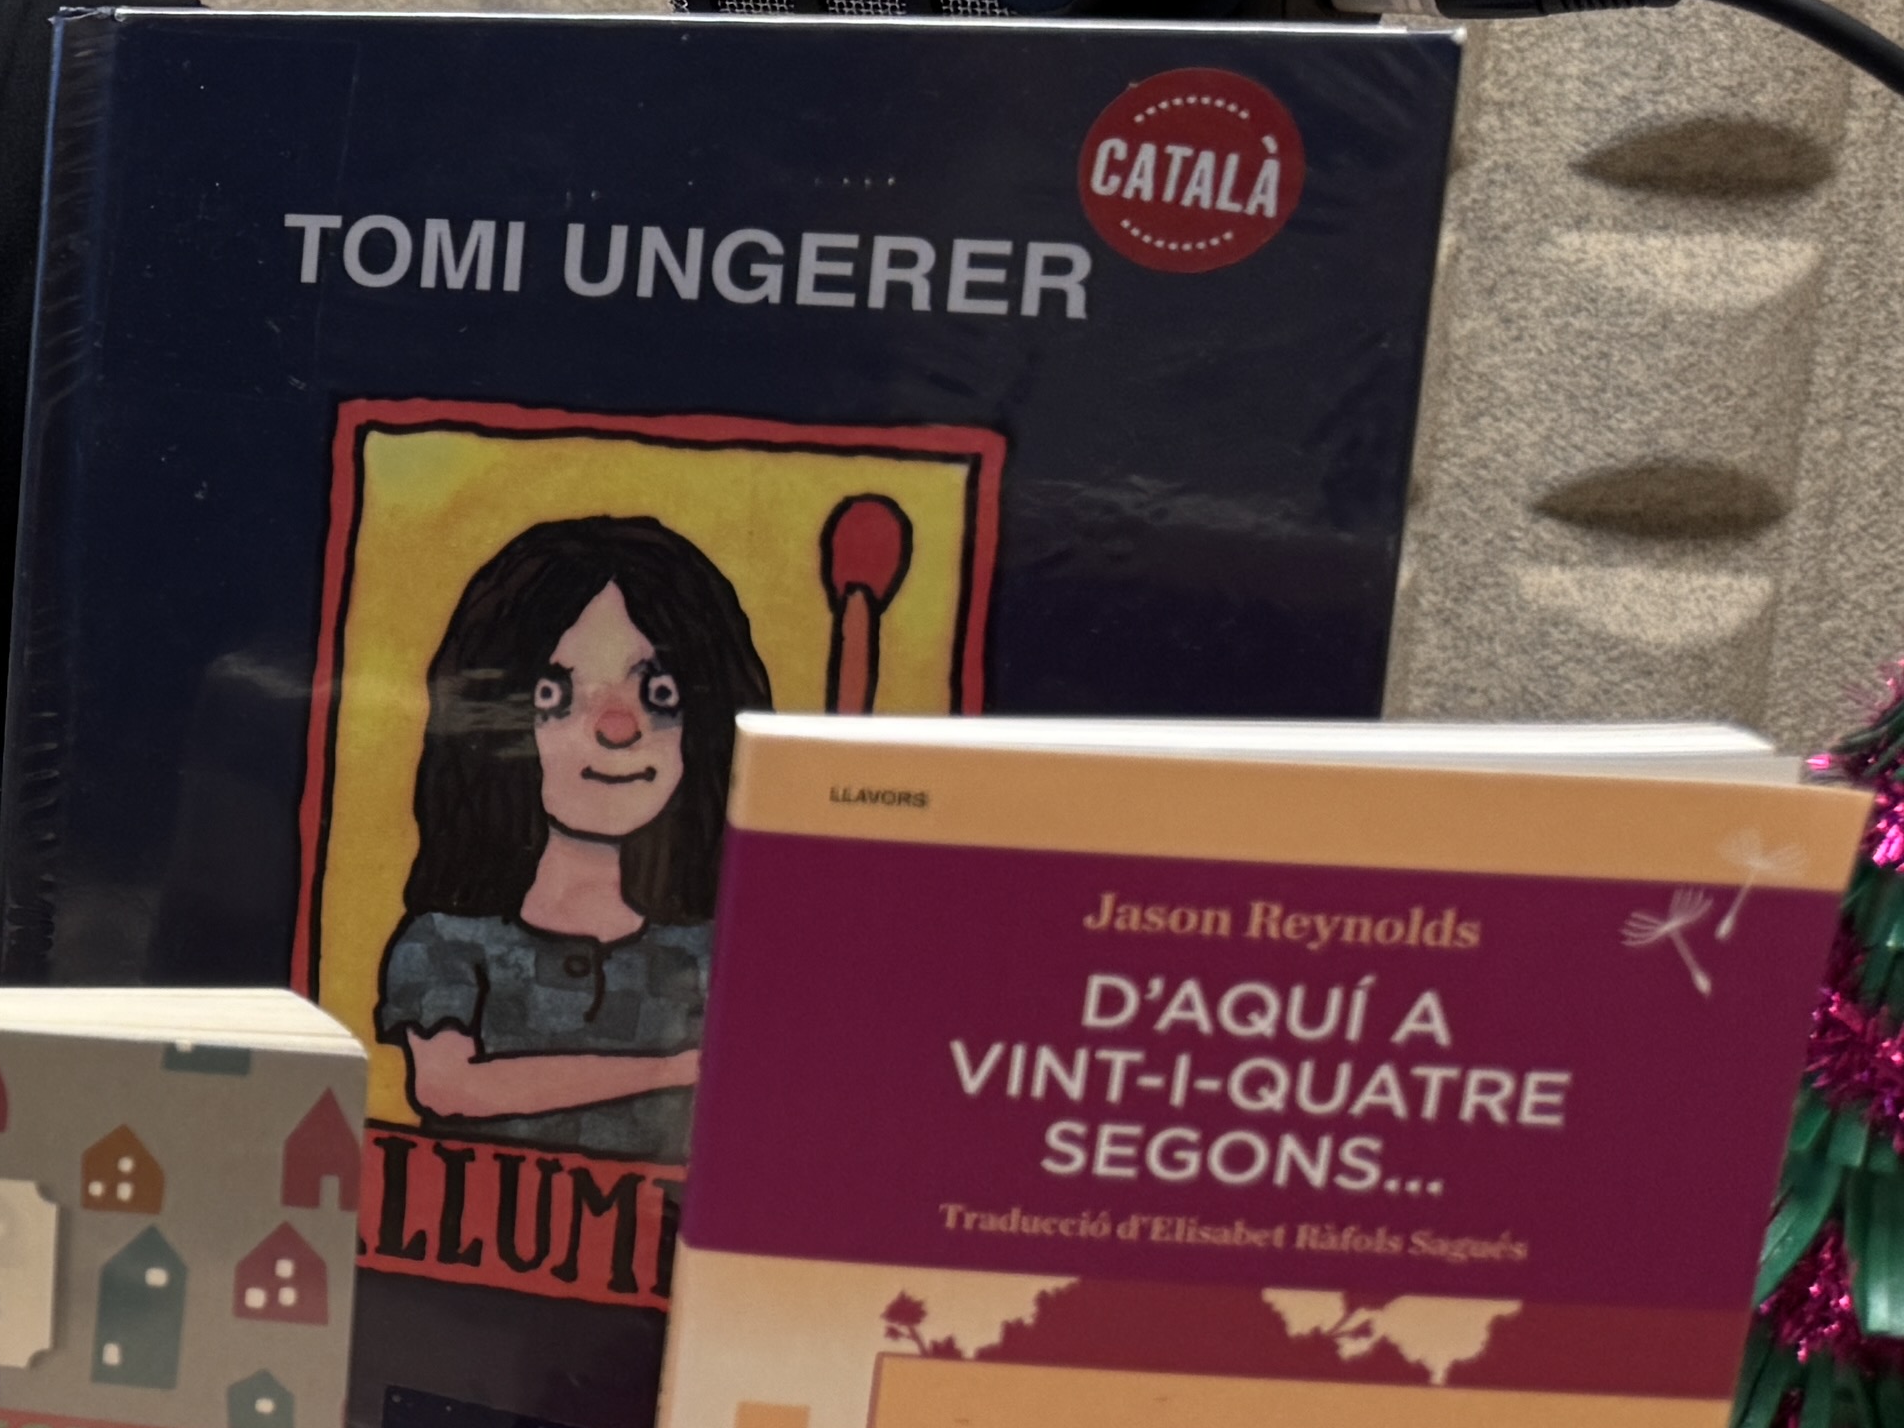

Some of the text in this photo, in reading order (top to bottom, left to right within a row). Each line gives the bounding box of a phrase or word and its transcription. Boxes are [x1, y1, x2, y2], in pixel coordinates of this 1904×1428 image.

[1090, 132, 1280, 220] CATALÀ
[283, 213, 1094, 320] TOMI UNGERER
[829, 786, 931, 811] LLAVORS
[1083, 891, 1484, 953] Jason Reynolds
[1390, 989, 1453, 1047] A
[947, 1039, 1572, 1127] VINT-I-QUATRE
[1039, 1119, 1445, 1197] SEGONS...
[355, 1134, 678, 1300] LLUM
[938, 1202, 1110, 1240] Traducció
